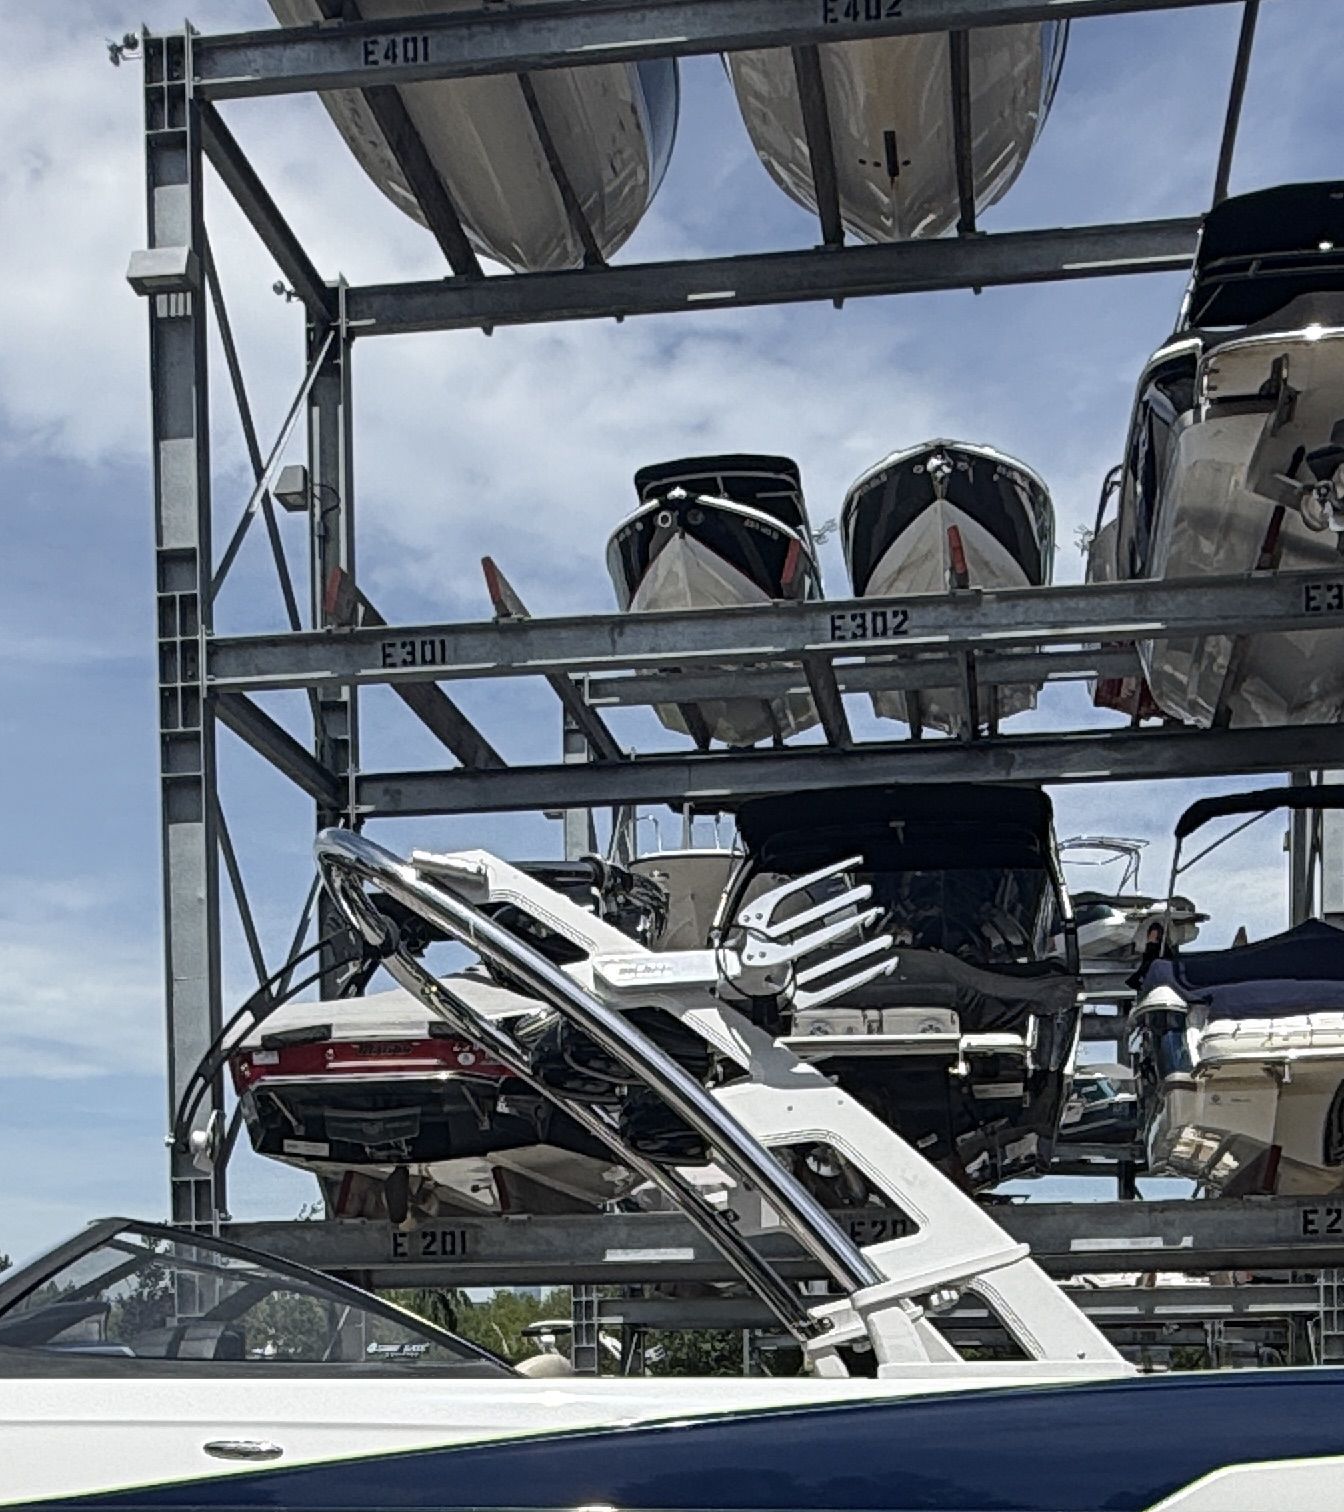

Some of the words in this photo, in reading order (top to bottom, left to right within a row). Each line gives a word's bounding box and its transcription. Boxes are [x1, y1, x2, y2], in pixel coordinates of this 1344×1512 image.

[823, 0, 902, 24] E402
[363, 36, 429, 66] E401
[830, 609, 909, 641] E302
[382, 638, 446, 668] E301
